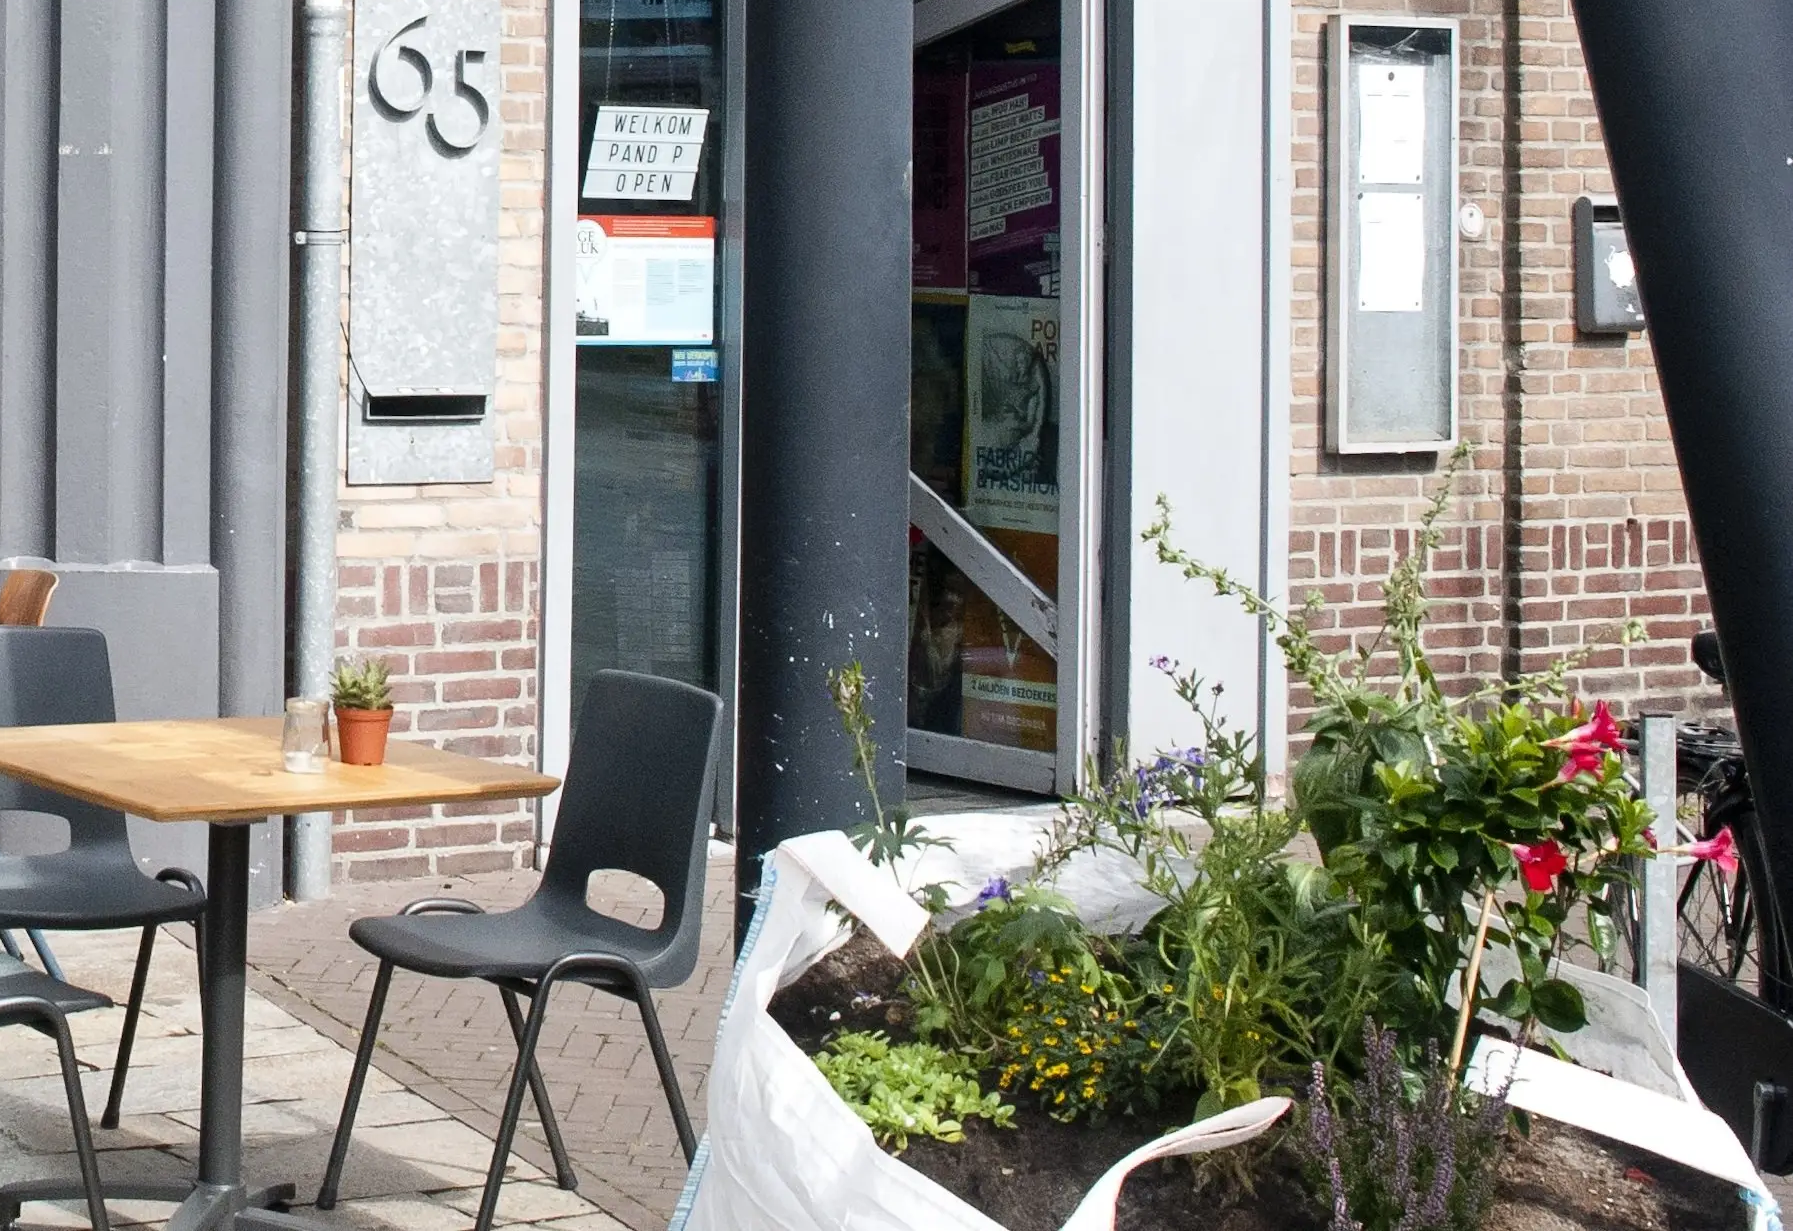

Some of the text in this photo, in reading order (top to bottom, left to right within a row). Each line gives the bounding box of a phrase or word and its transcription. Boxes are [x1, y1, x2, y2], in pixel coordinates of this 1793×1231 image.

[368, 14, 489, 160] 65
[614, 114, 692, 135] WELKOM
[608, 143, 684, 163] PAND P
[616, 173, 673, 193] OPEN
[1031, 319, 1060, 341] PO
